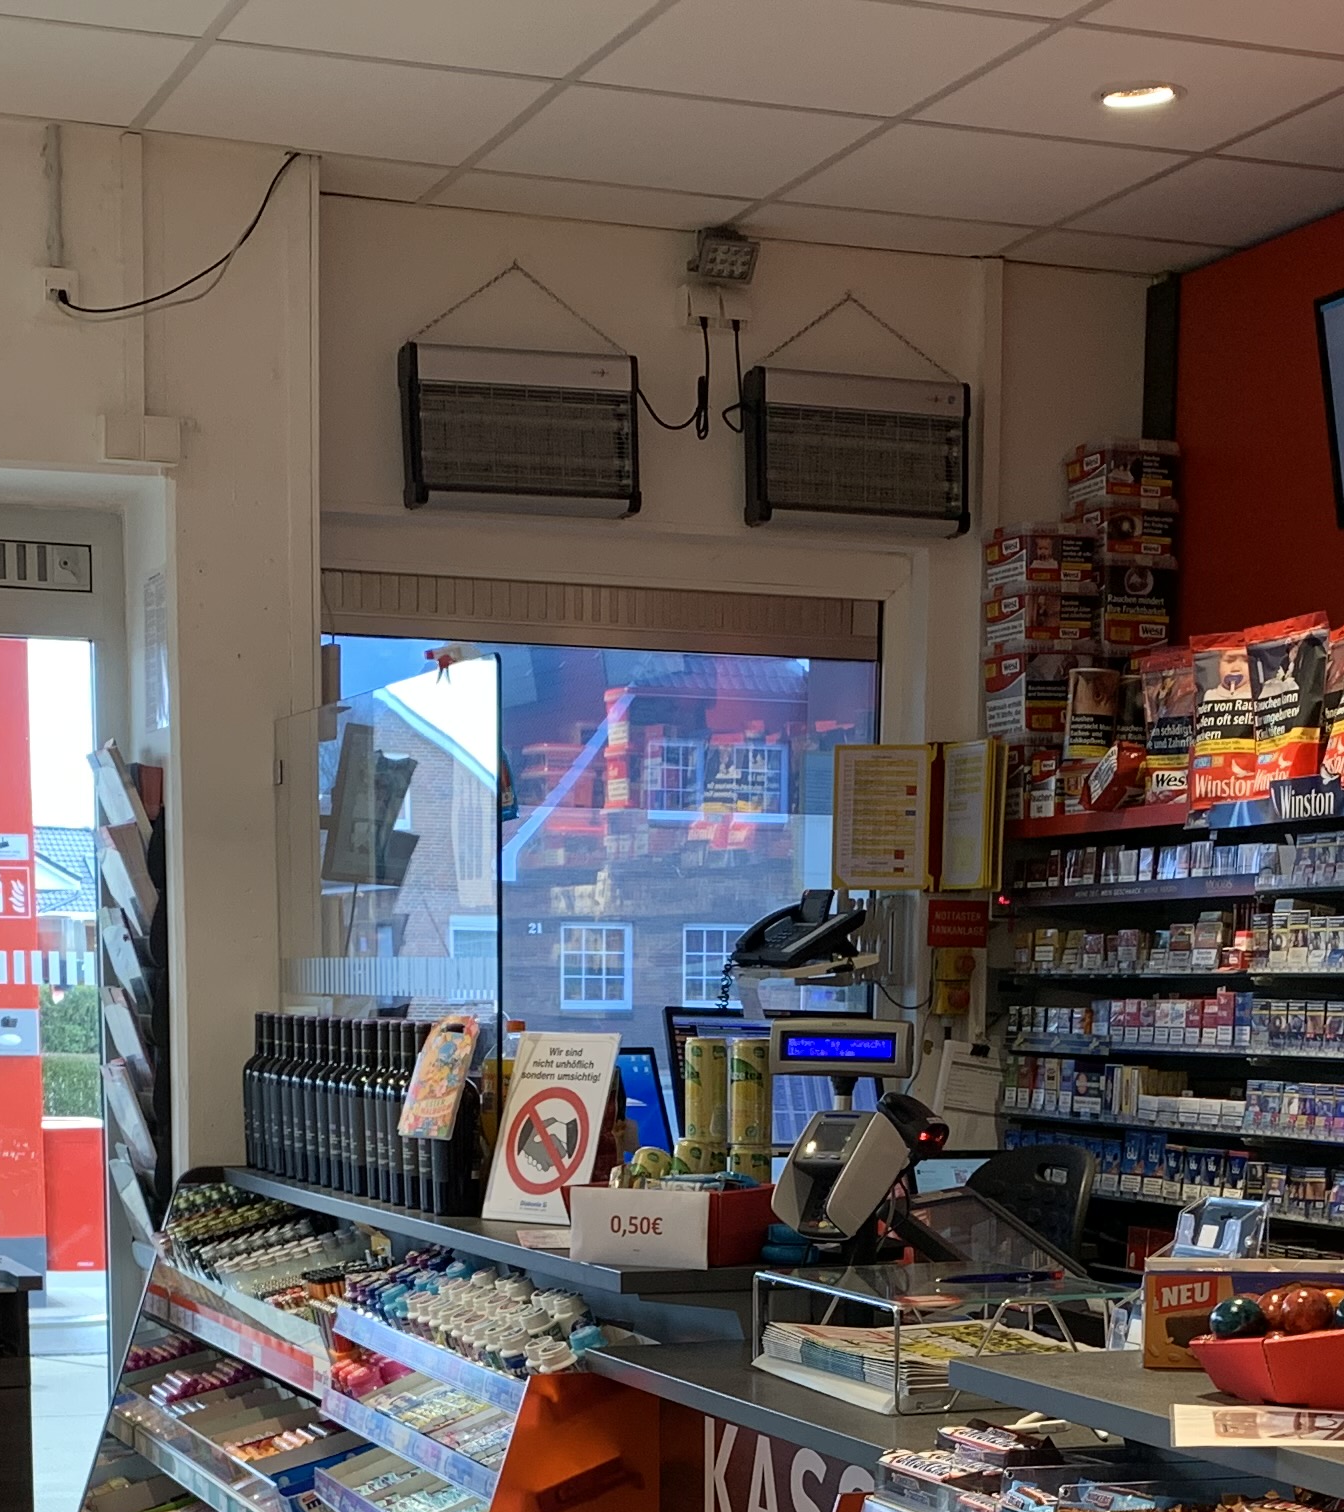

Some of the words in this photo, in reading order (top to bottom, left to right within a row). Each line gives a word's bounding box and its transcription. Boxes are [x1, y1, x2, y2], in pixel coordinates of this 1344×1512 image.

[1141, 625, 1164, 637] West
[1279, 785, 1335, 819] Winston
[934, 910, 982, 922] NOTTASTER
[527, 921, 543, 935] 21
[930, 925, 985, 937] TANKANLAGE
[549, 1047, 563, 1057] Wir
[565, 1047, 583, 1057] sind
[532, 1060, 554, 1069] nicht
[556, 1059, 594, 1070] unhöflich
[520, 1071, 555, 1081] sondern
[557, 1072, 601, 1083] umsichtig!
[609, 1214, 664, 1238] 0,50€
[1161, 1281, 1213, 1310] NEU
